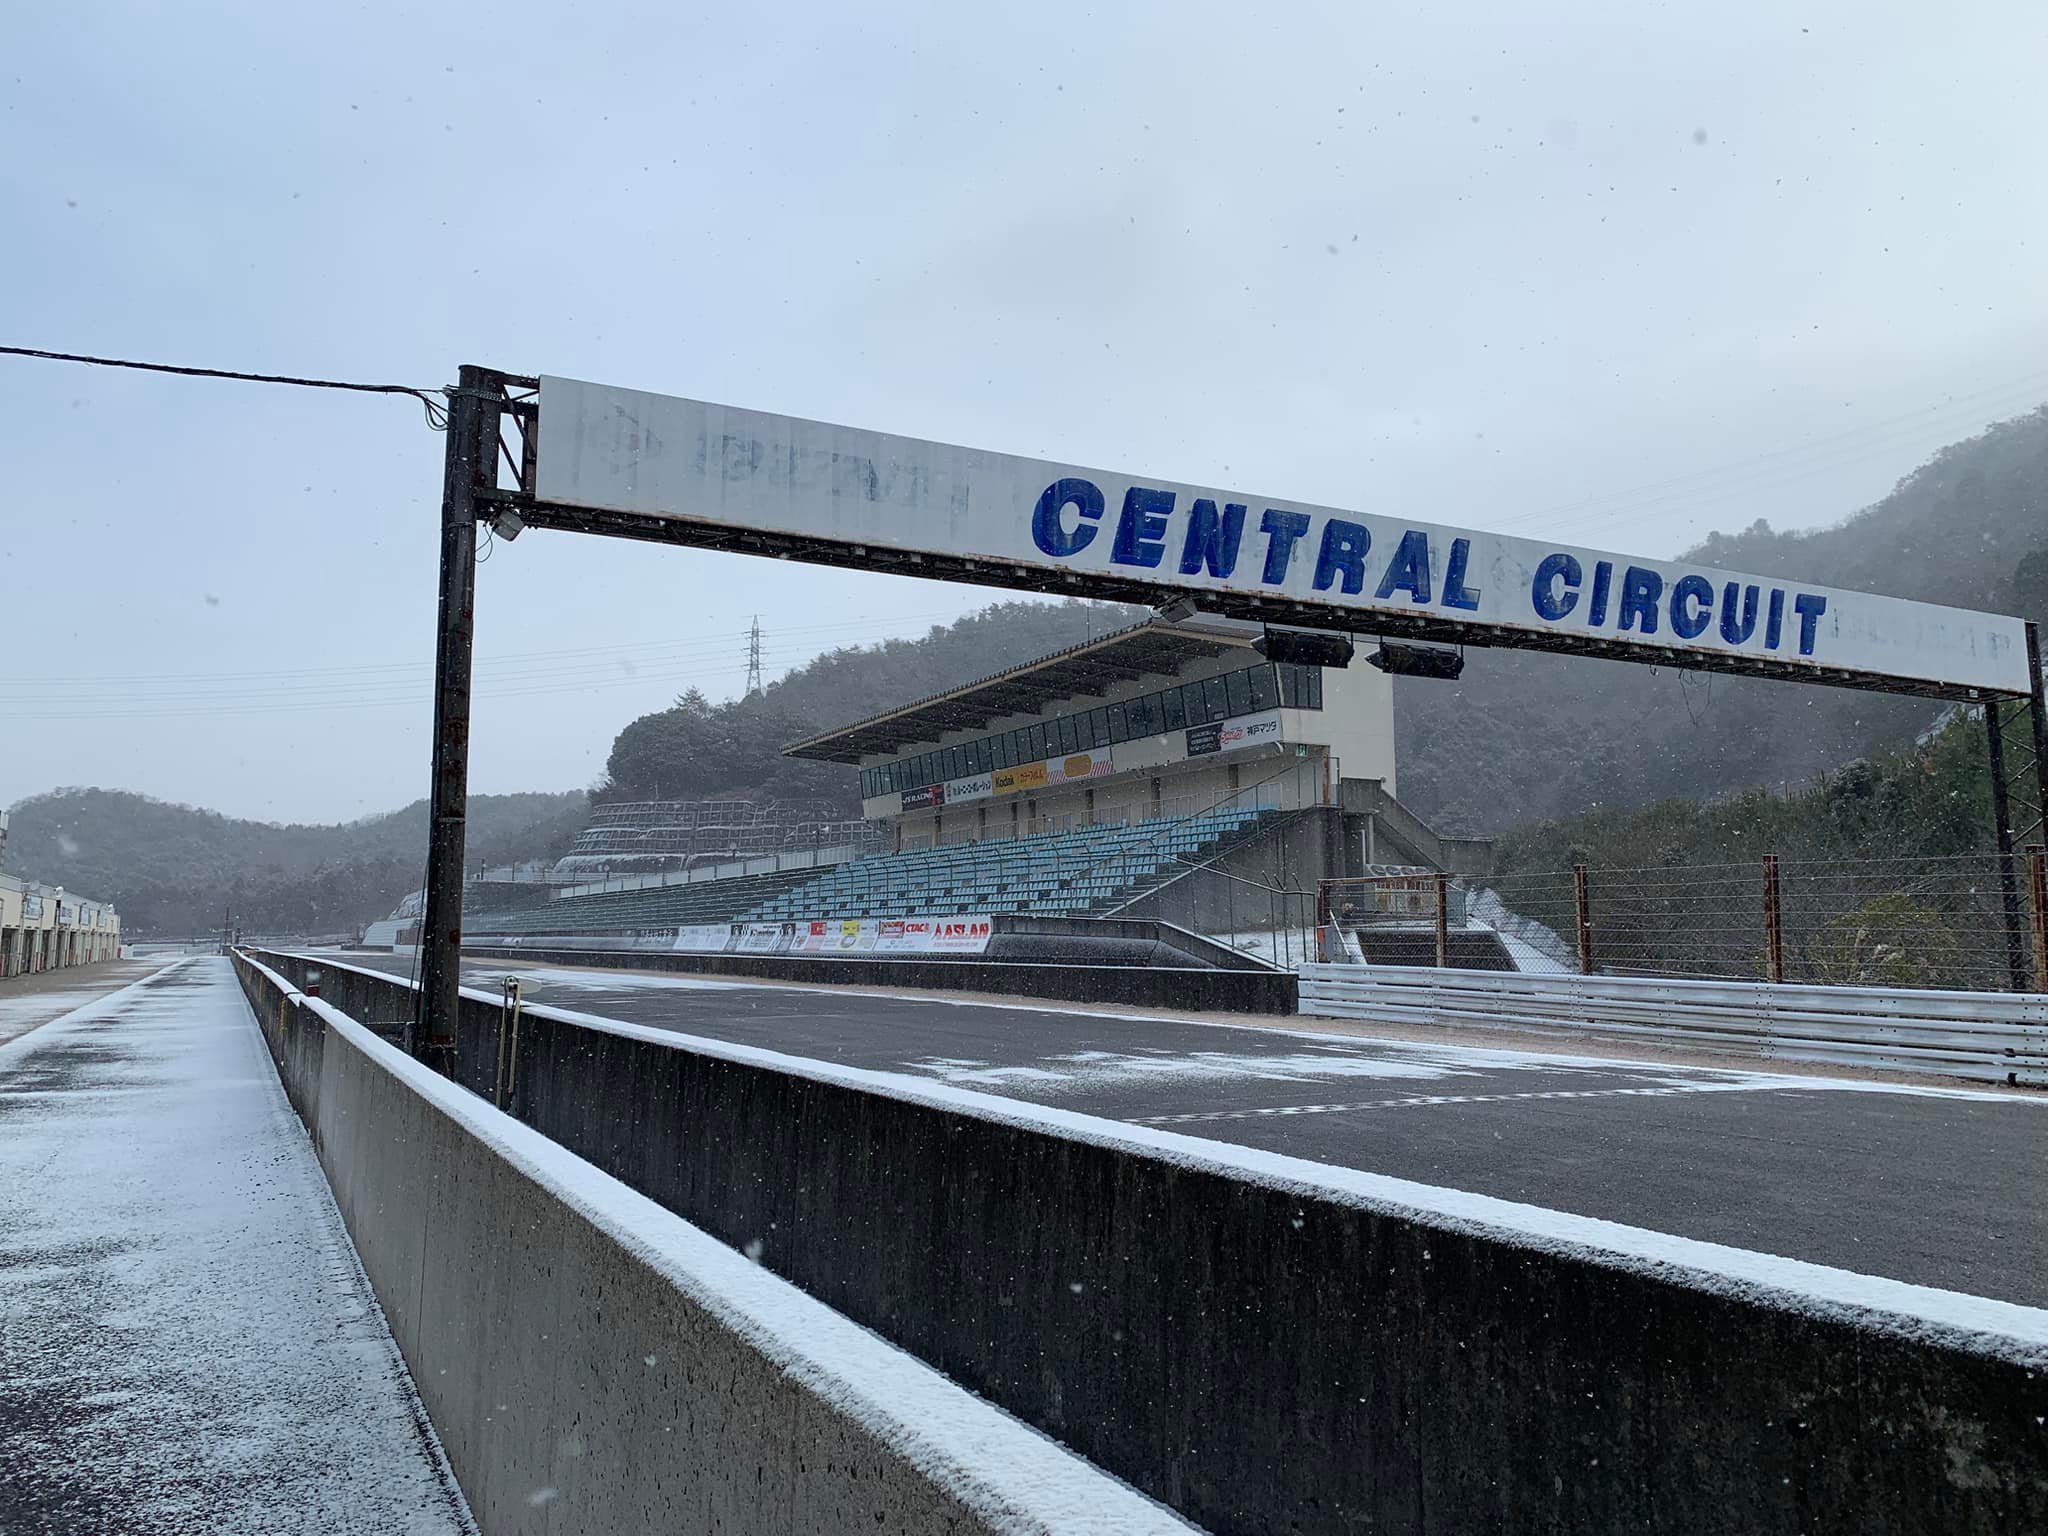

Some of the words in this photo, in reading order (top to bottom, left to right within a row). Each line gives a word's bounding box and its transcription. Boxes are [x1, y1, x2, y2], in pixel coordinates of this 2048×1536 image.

[1031, 477, 1481, 611] CENTRAL
[1532, 553, 1827, 656] CIRCUIT
[995, 774, 1014, 787] Kodak
